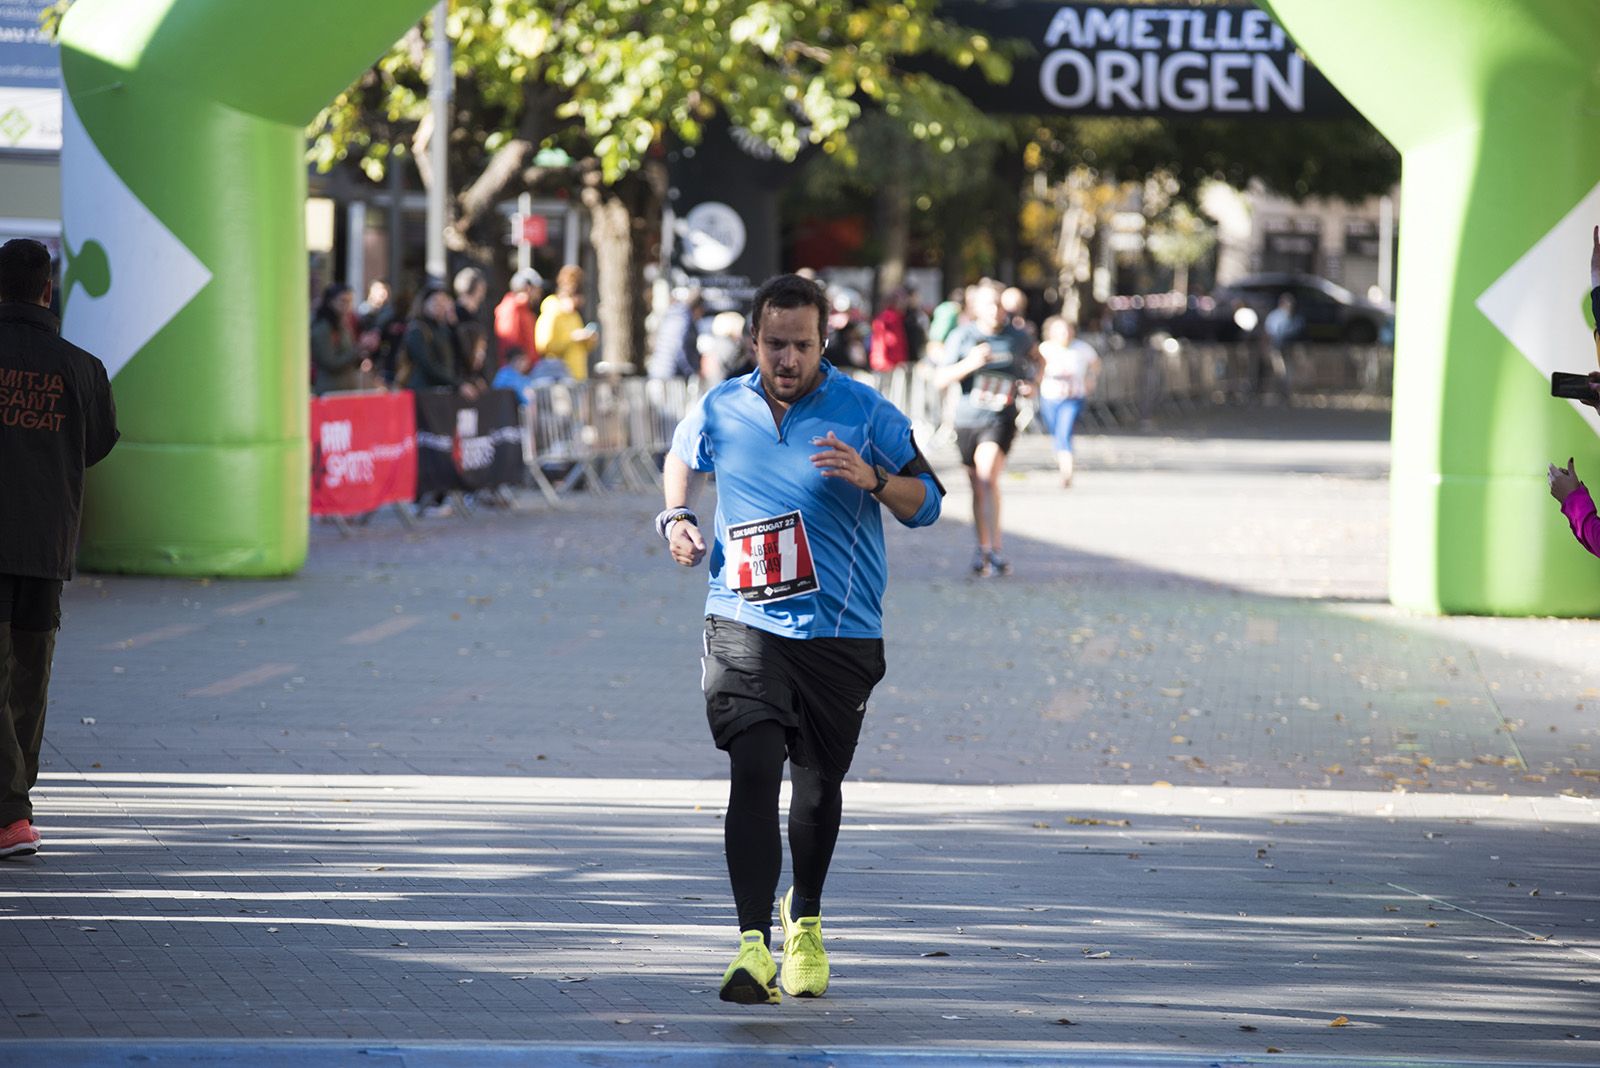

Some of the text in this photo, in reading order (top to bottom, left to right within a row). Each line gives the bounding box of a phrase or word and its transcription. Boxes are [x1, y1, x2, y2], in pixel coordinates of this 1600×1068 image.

[1039, 48, 1306, 113] ORIGEN
[0, 367, 64, 393] MITJA
[0, 407, 66, 433] UGAT
[757, 520, 784, 533] CUGAT
[784, 518, 795, 526] 22
[752, 556, 781, 576] 2049
